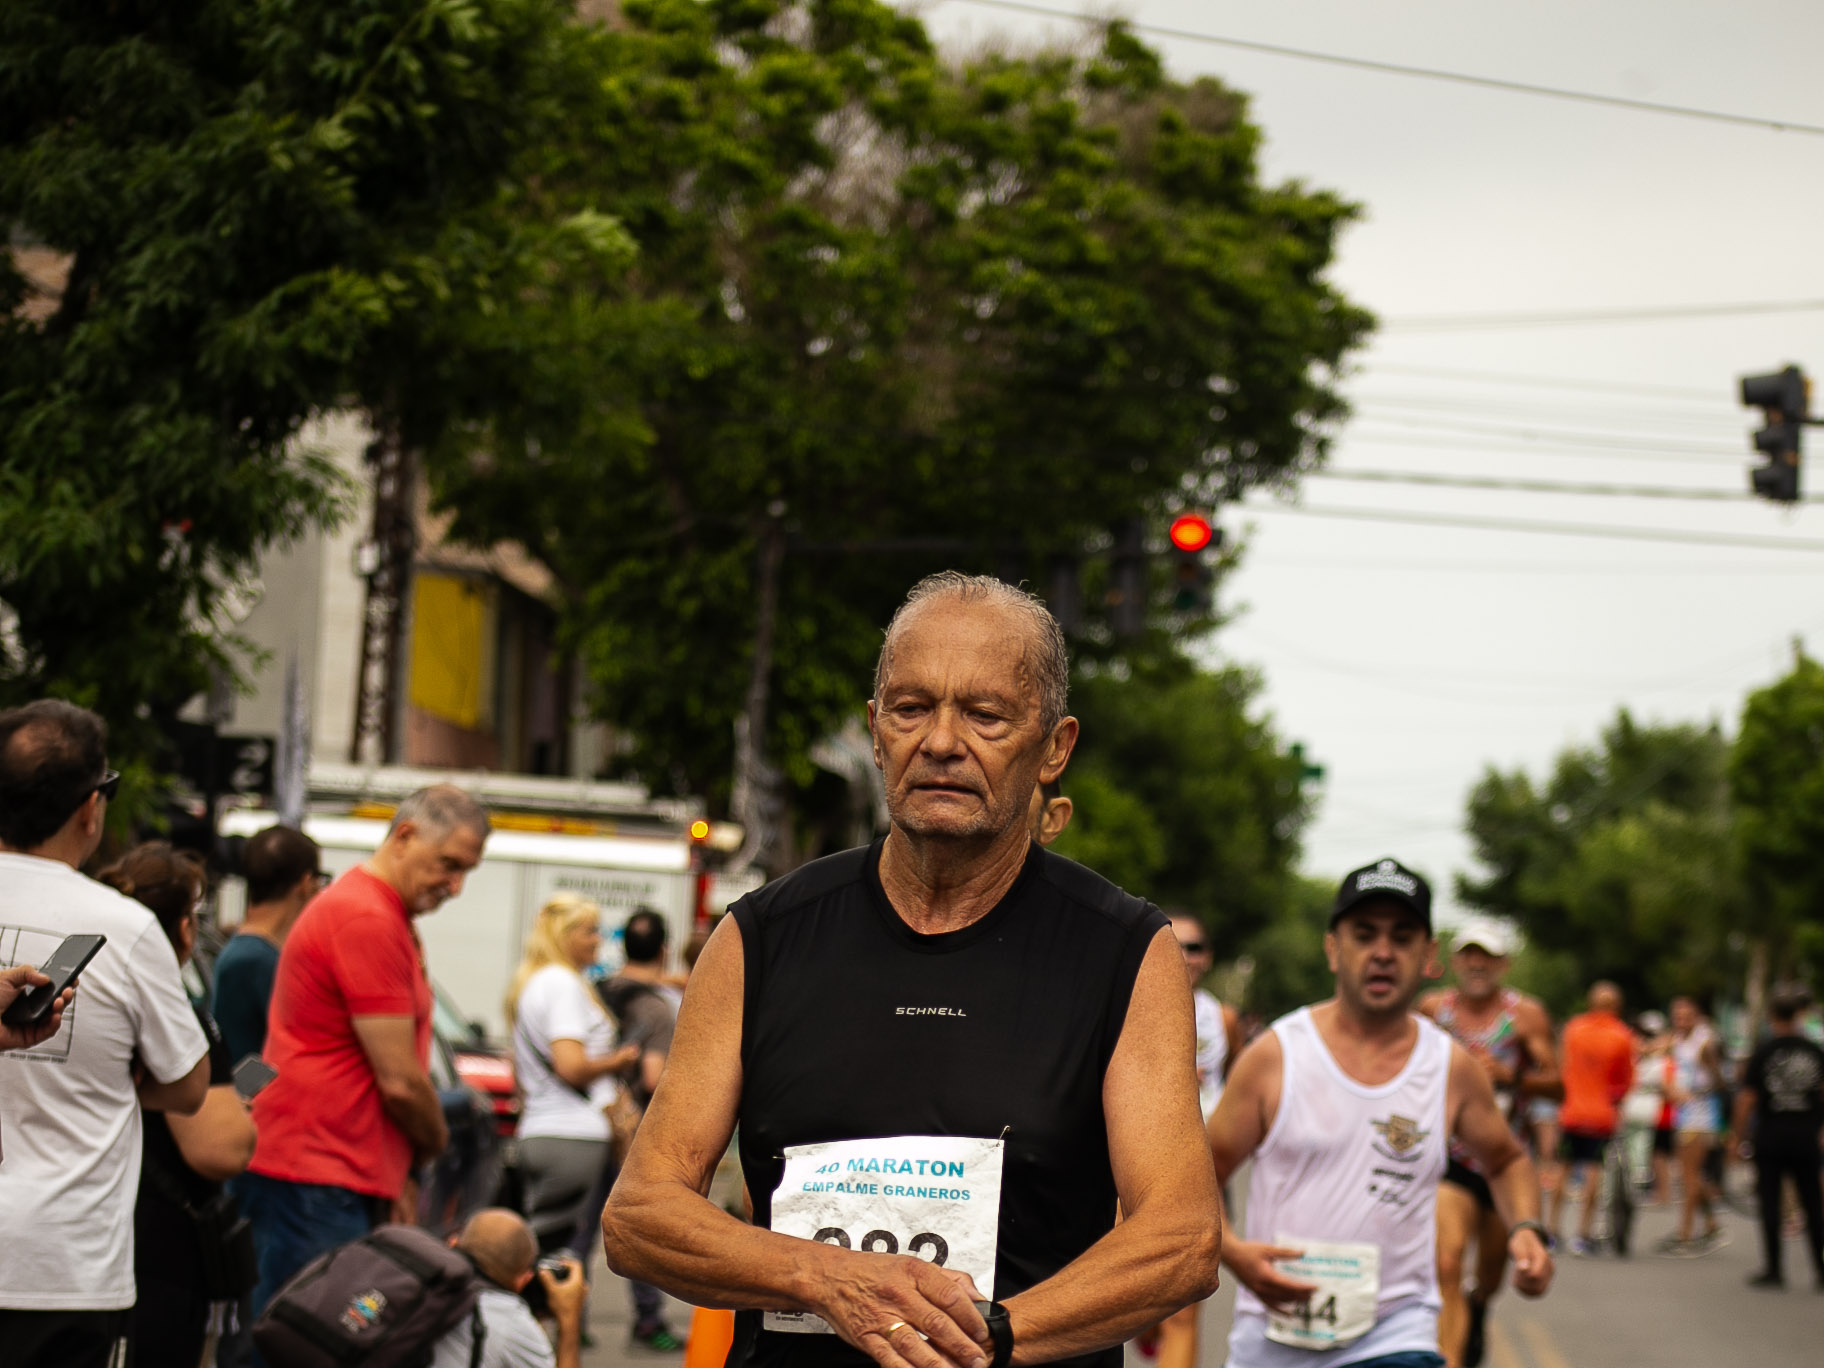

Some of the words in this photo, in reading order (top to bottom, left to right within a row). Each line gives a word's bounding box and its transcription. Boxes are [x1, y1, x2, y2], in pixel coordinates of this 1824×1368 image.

[896, 1007, 967, 1017] SCHNELL
[815, 1161, 840, 1175] 40
[847, 1158, 965, 1178] MARATON
[802, 1182, 878, 1195] EMPALME
[883, 1185, 971, 1201] GRANEROS
